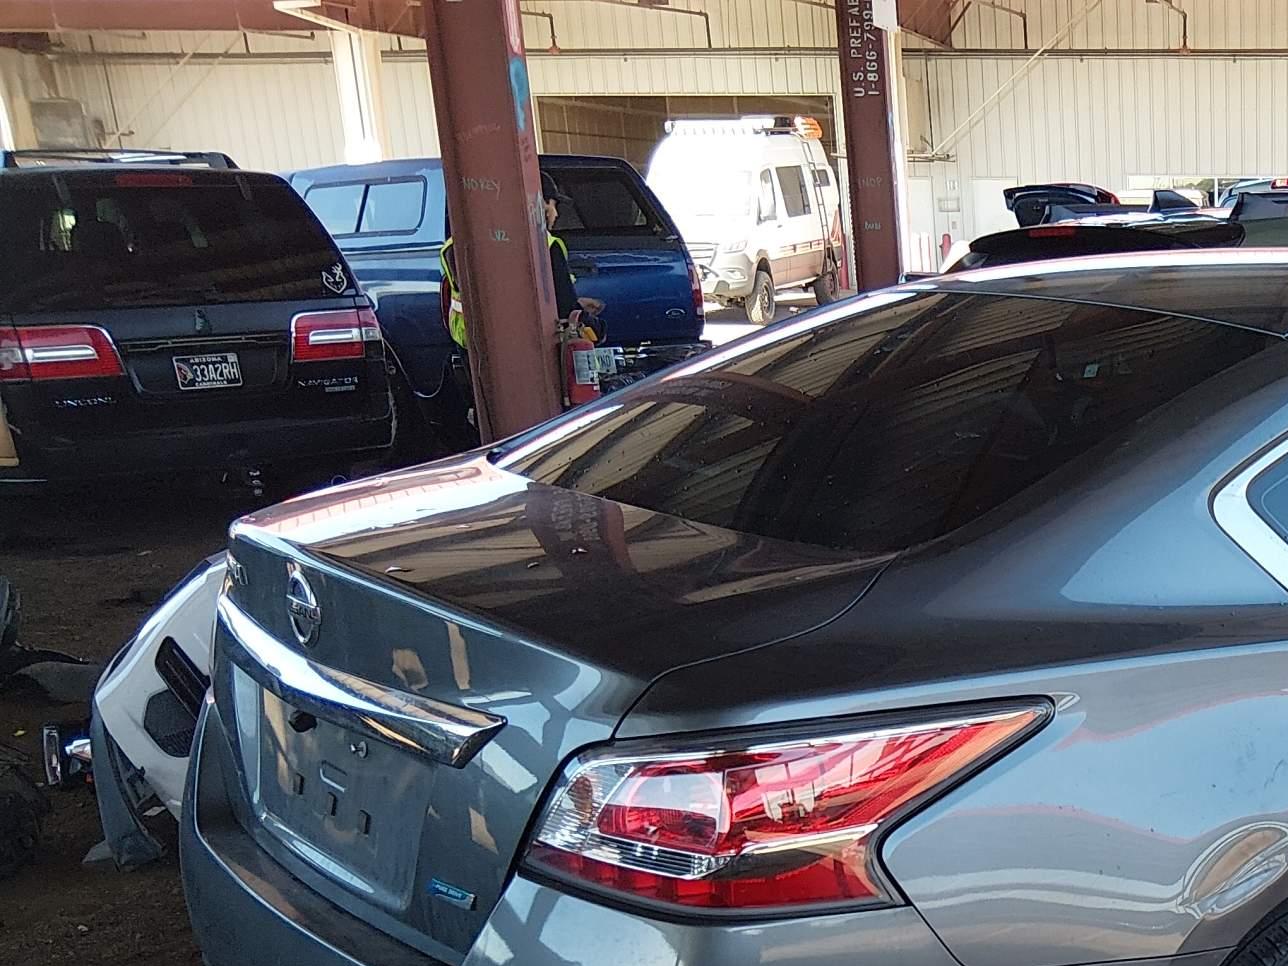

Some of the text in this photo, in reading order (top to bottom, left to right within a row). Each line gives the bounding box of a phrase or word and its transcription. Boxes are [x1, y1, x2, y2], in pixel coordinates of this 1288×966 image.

[862, 0, 881, 95] 1-866-799-
[852, 66, 866, 97] U.S.
[192, 362, 239, 382] 33A2RH
